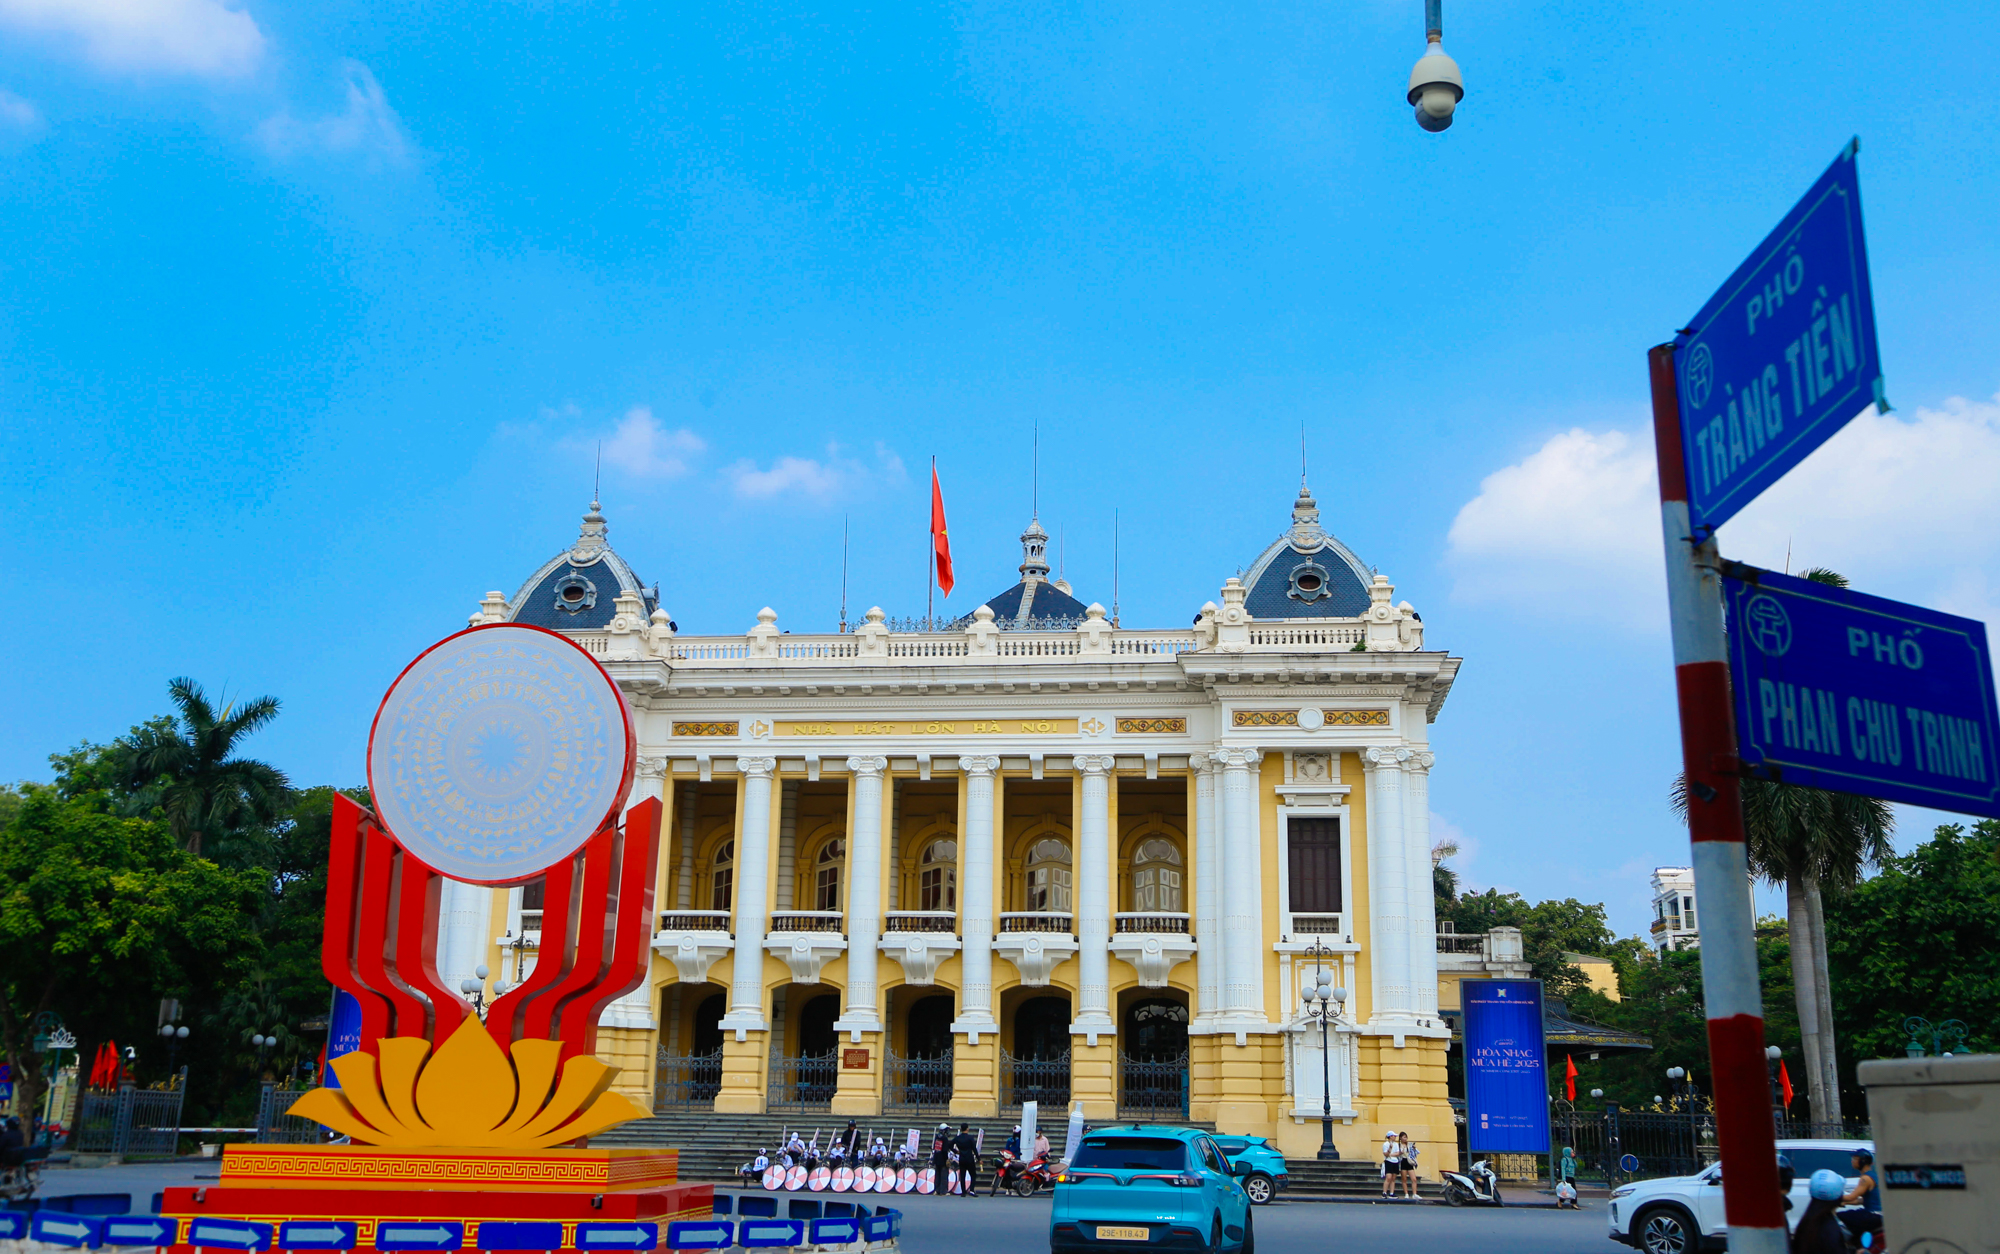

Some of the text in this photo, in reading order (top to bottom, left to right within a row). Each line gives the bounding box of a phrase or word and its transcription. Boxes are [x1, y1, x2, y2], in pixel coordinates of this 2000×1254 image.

[1746, 230, 1804, 336] PHỐ
[1696, 284, 1857, 496] TRÀNG TIỀN
[1847, 627, 1924, 670] PHỐ
[793, 719, 1059, 735] NHÀ HÁT LỚN HÀ NỘI
[1758, 678, 1987, 783] PHAN CHU TRINH
[1471, 1057, 1540, 1068] MÙA HÈ 2025
[1477, 1046, 1533, 1059] HÒA NHẠC
